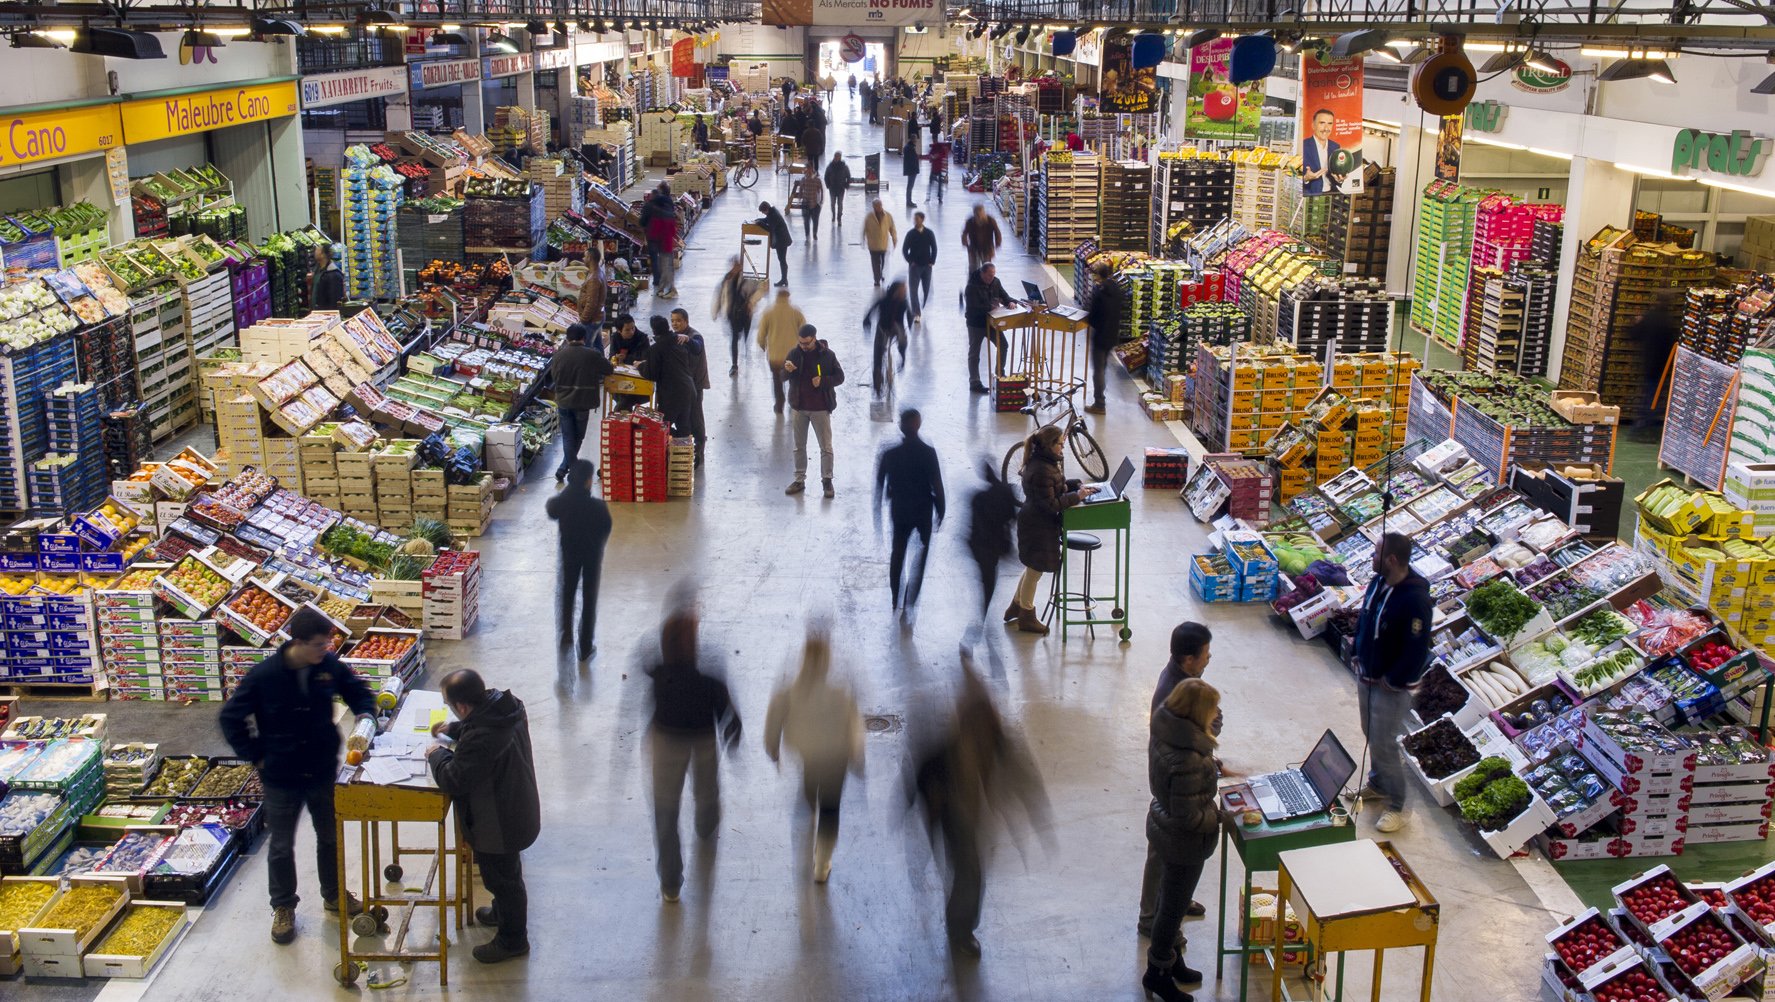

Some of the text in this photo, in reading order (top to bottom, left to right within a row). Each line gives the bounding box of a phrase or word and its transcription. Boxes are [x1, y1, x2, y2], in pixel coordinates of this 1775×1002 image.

[870, 0, 889, 8] NO
[893, 0, 933, 8] FUMIS
[1196, 53, 1230, 64] DESLUMB
[423, 64, 447, 85] GONZALO
[1520, 66, 1569, 78] TRUVAL
[304, 76, 393, 102] 6019 NAVARRETE Fruits
[165, 90, 270, 132] Maleubre Cano
[1465, 101, 1505, 134] rats
[9, 119, 66, 160] Cano
[98, 135, 113, 146] 6017
[1671, 128, 1765, 176] prats
